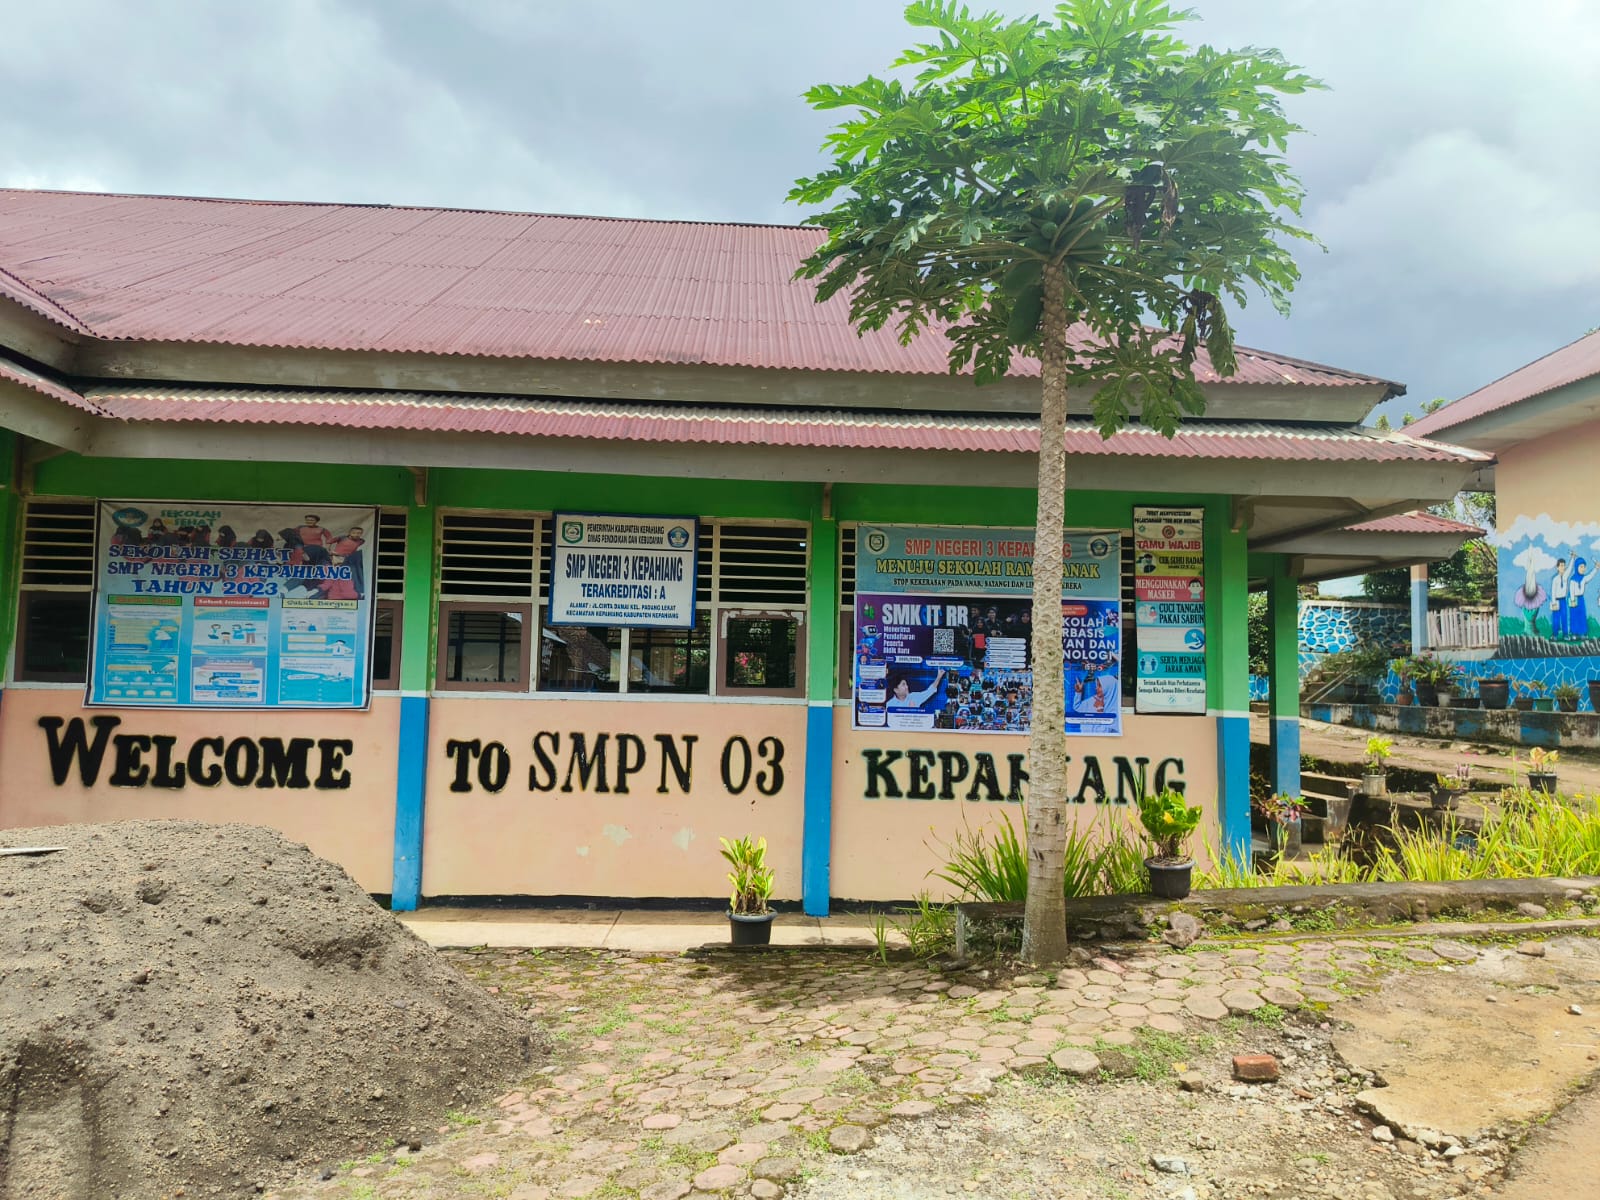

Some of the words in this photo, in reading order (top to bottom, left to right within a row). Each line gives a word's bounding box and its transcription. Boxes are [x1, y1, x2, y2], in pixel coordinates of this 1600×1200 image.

[160, 510, 222, 519] SEKOLAH
[174, 518, 217, 527] SEHAT
[905, 538, 932, 555] SMP
[935, 540, 982, 556] NEGERI
[986, 540, 994, 557] 3
[1137, 541, 1165, 550] TAMU
[1169, 541, 1201, 550] WAJIB
[109, 545, 210, 559] SEKOLAH
[219, 548, 293, 561] SEHAT
[108, 562, 144, 575] SMP
[151, 563, 219, 577] NEGERI
[226, 564, 238, 578] 3
[244, 565, 351, 580] KEPAHIANG
[566, 553, 586, 578] SMP
[588, 554, 622, 580] NEGERI
[624, 558, 630, 580] 3
[632, 556, 683, 582] KEPAHIANG
[876, 559, 935, 574] MENUJU
[938, 560, 1002, 577] SEKOLAH
[131, 580, 213, 594] TAHUN
[223, 582, 278, 595] 2023
[894, 578, 909, 586] STOP
[910, 578, 946, 586] KEKERASAN
[948, 579, 963, 587] PADA
[985, 580, 1010, 588] SAYANGI
[1136, 579, 1186, 589] MENGGUNAKAN
[581, 583, 651, 599] TERAKREDITASI
[660, 586, 666, 600] A
[1148, 590, 1176, 599] MASKER
[882, 603, 921, 626] SMK
[926, 604, 941, 627] IT
[1159, 603, 1174, 613] CUCI
[1176, 603, 1204, 614] TANGAN
[1062, 617, 1104, 628] KOLAH
[1159, 614, 1180, 624] PAKAI
[1181, 614, 1205, 624] SABUN
[1089, 640, 1116, 650] DAN
[1160, 656, 1177, 664] SERTA
[38, 716, 353, 789] WELCOME
[446, 739, 511, 794] TO
[720, 735, 785, 796] 03
[861, 749, 1186, 805] KEPAHANG
